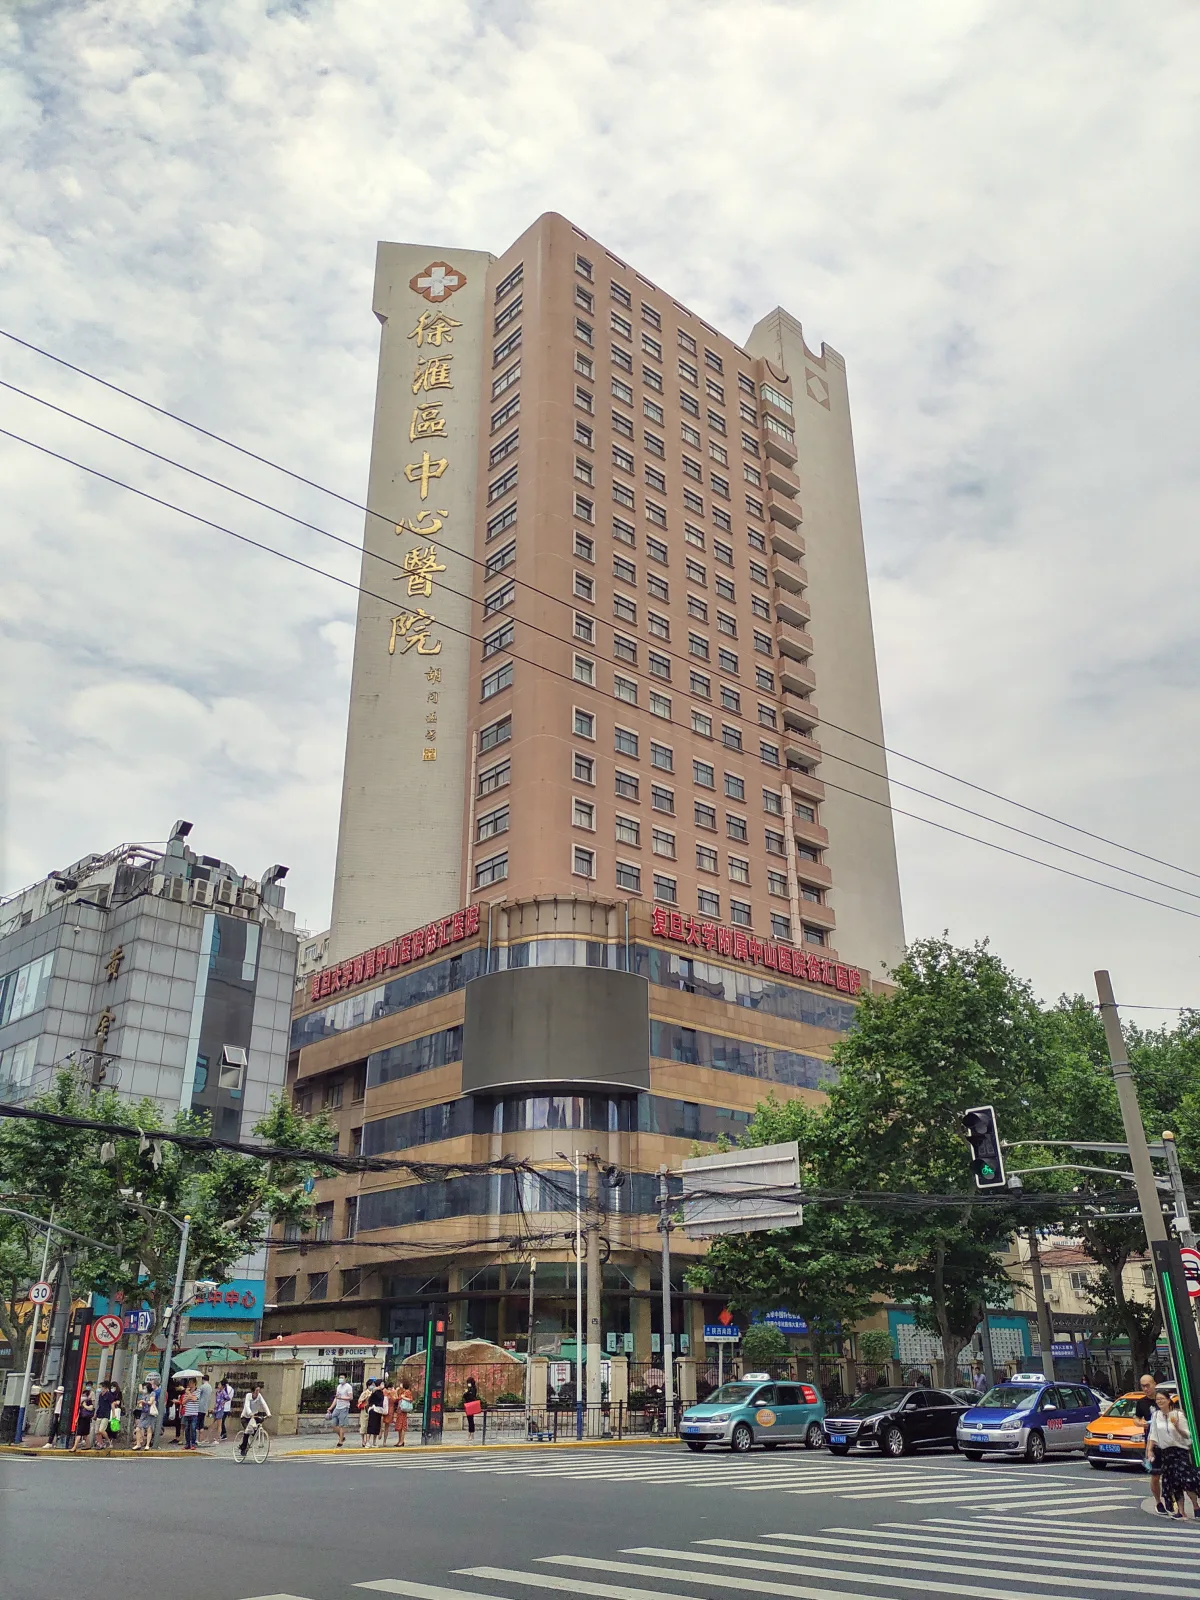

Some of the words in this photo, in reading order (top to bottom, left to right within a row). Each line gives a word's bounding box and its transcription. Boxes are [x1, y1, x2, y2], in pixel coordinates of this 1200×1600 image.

[311, 903, 481, 1001] 复旦大学附属中山医院徐汇医院
[651, 906, 862, 995] 复旦大学附属中山医院徐汇医院
[33, 1287, 48, 1299] 30
